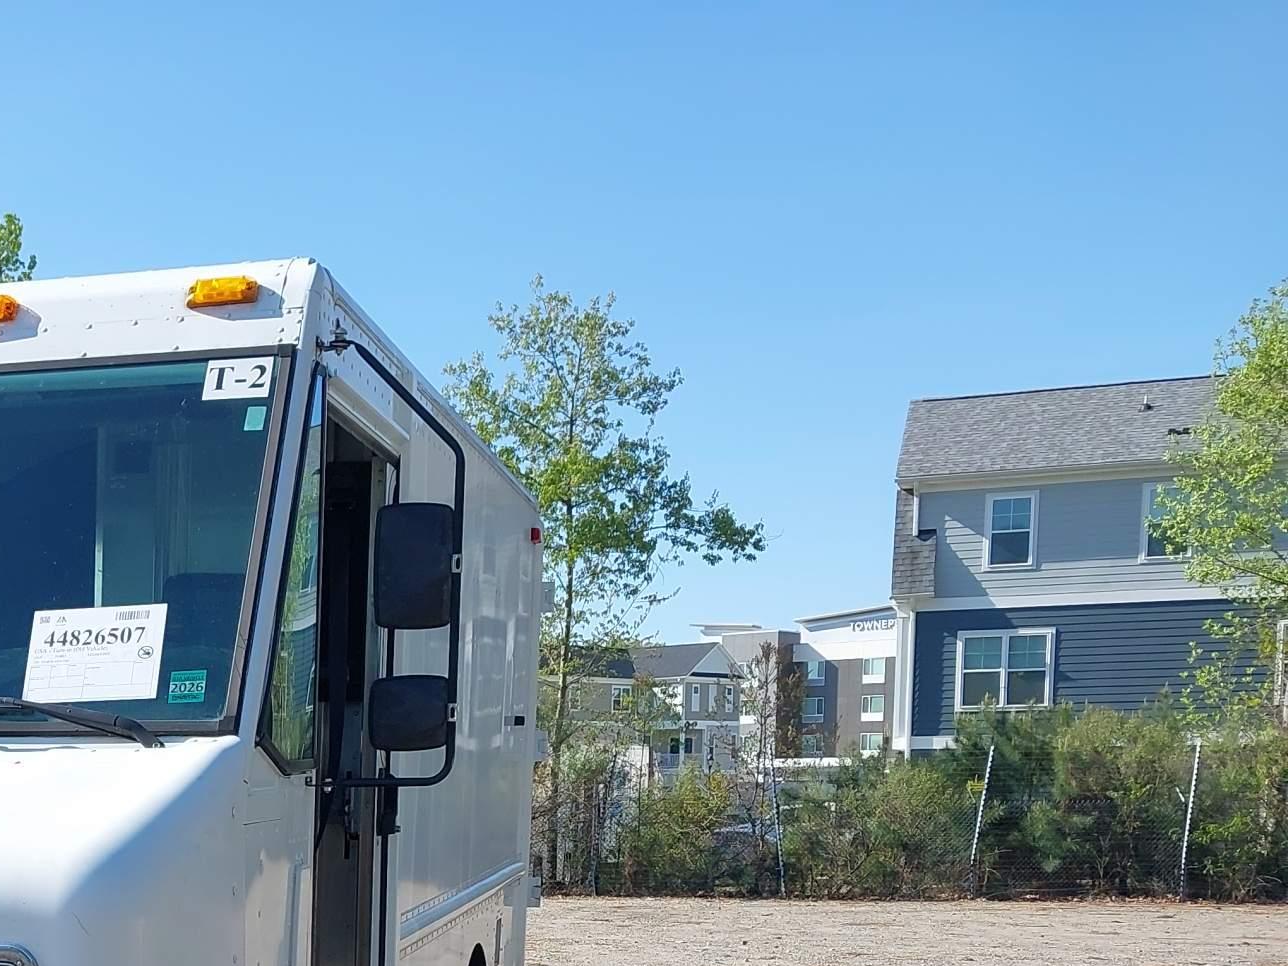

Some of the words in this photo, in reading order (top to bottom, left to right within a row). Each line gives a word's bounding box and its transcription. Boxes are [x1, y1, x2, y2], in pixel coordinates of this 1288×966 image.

[209, 364, 267, 391] T-2
[850, 619, 897, 632] TOWNEP
[43, 626, 146, 648] 44826507
[170, 682, 204, 693] 2026
